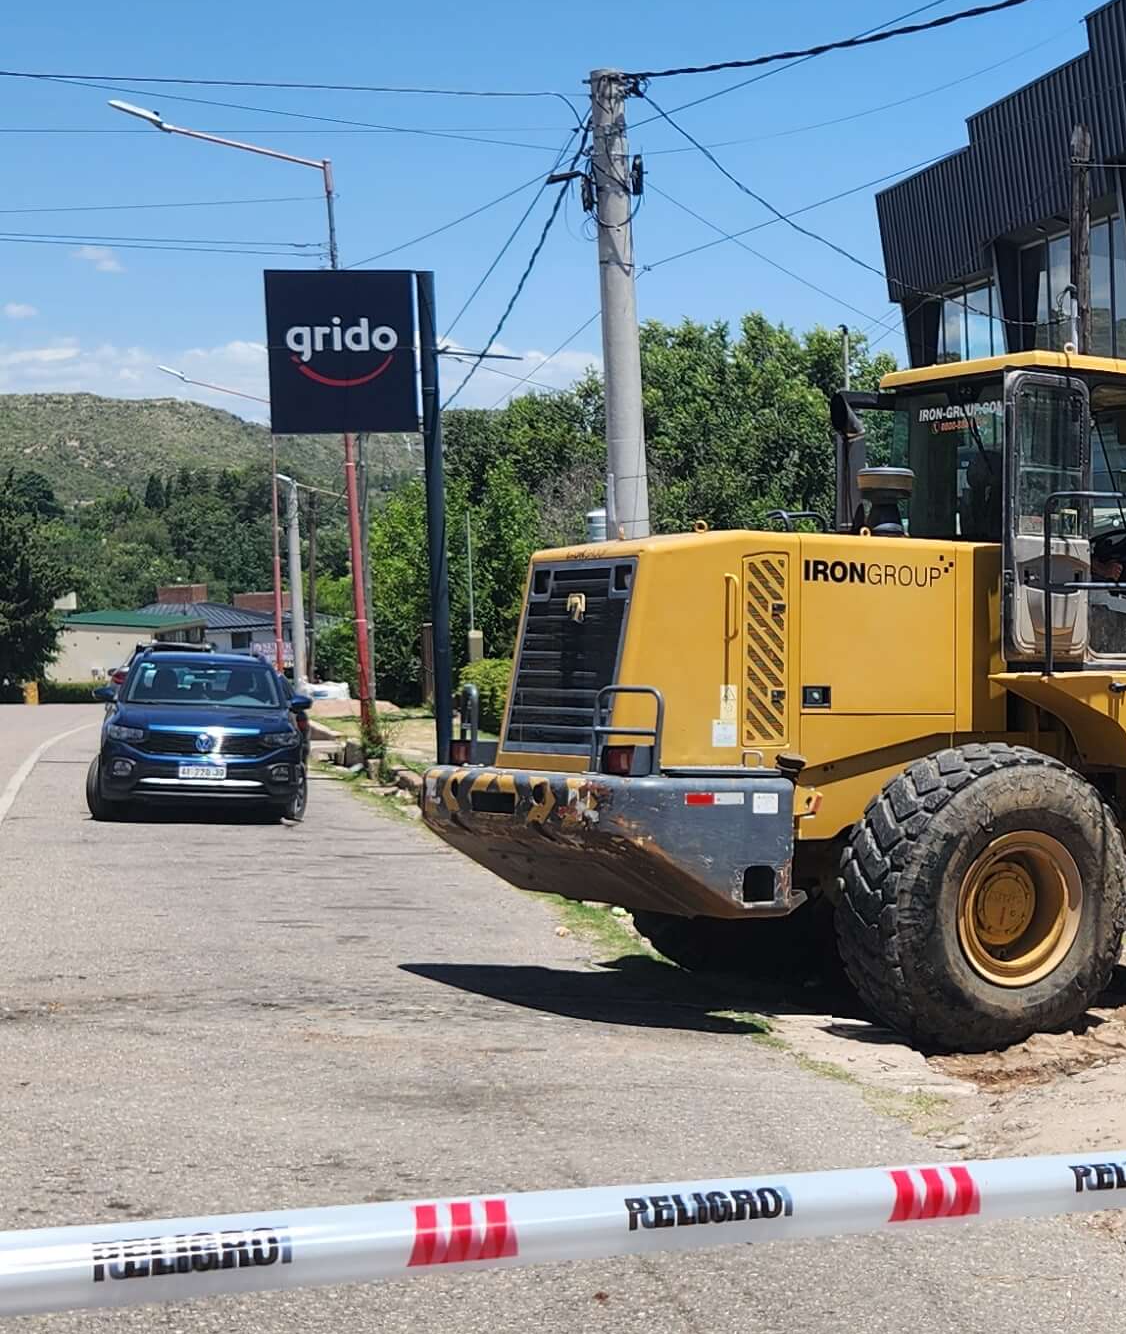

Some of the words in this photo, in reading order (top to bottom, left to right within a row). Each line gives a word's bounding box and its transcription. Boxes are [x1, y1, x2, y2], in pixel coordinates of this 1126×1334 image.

[286, 318, 398, 363] grido
[804, 559, 941, 588] IRONGROUP
[624, 1187, 792, 1231] PELIGRO
